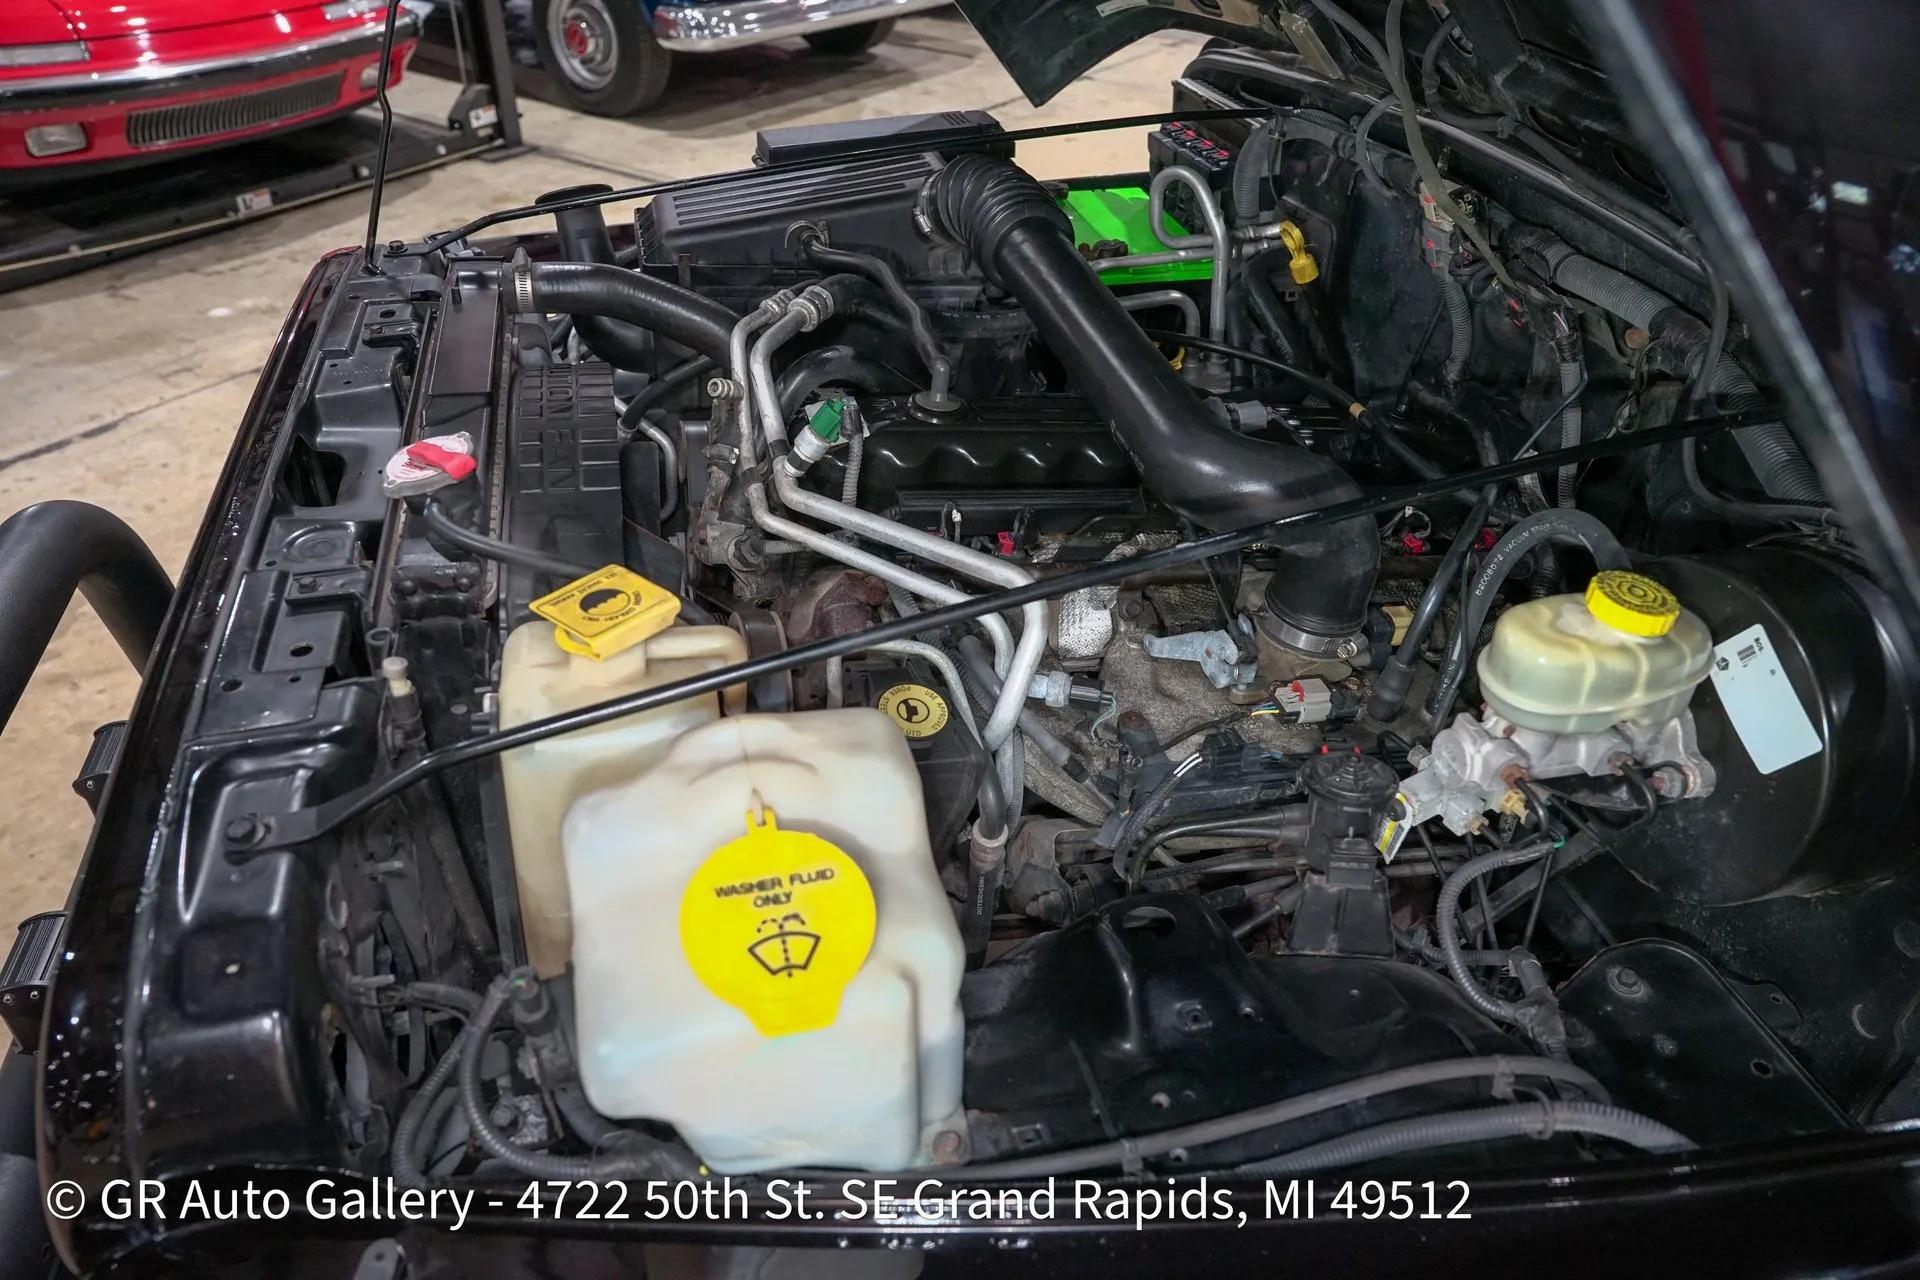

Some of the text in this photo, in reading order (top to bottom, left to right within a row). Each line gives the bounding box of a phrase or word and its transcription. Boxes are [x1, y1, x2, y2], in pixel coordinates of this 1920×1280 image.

[547, 367, 576, 492] UTION FAN
[888, 685, 912, 696] POWER
[924, 689, 947, 731] USE APPROVED
[714, 867, 835, 898] WASHER FLUID
[753, 890, 793, 909] ONLY
